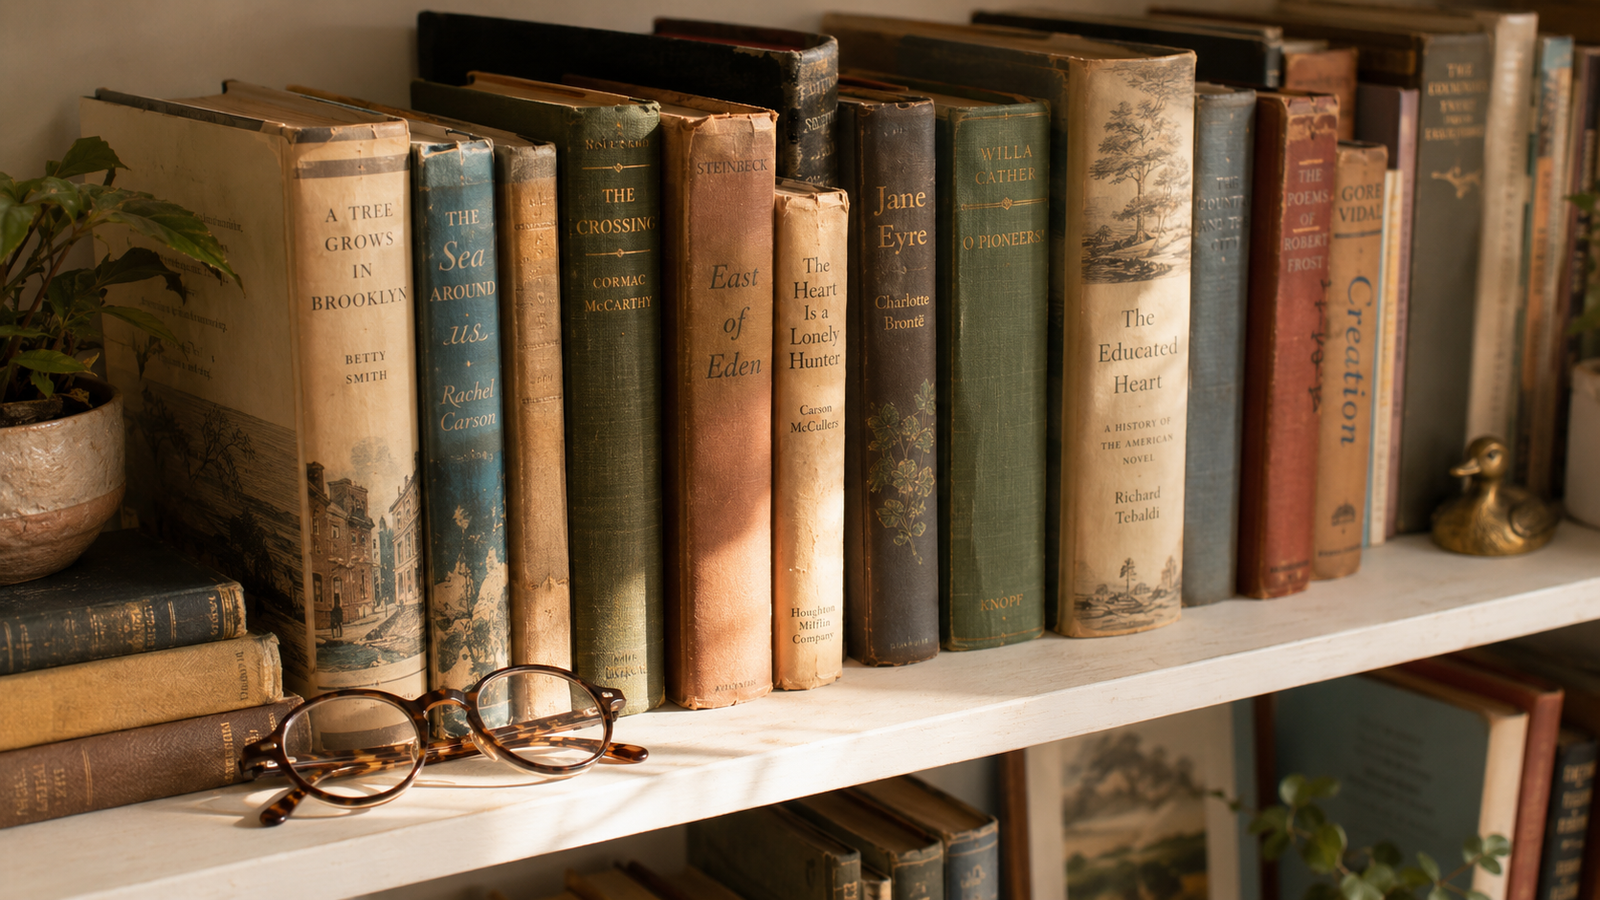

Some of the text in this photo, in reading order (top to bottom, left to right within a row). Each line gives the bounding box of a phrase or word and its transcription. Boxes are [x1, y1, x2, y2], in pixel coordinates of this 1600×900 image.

[980, 144, 1033, 161] WILLA
[697, 158, 768, 175] STEINBECK
[1298, 168, 1323, 183] THE
[975, 167, 1036, 185] CATHER
[602, 187, 635, 203] THE
[873, 186, 926, 216] Jane
[1287, 189, 1329, 207] POEMS
[1341, 183, 1382, 202] GORE
[325, 203, 394, 223] A TREE
[445, 209, 480, 227] THE
[1300, 211, 1315, 226] OF
[1339, 204, 1383, 223] VIDAL
[576, 216, 655, 235] CROSSING
[325, 231, 394, 252] GROWS
[878, 224, 928, 255] Eyre
[963, 229, 1045, 251] O PIONEERS!
[1284, 233, 1328, 251] ROBERT
[439, 240, 485, 272] Sea
[803, 256, 831, 274] The
[1287, 255, 1324, 273] FROST
[353, 263, 372, 279] IN
[708, 264, 759, 290] East
[593, 274, 646, 289] CORMAC
[793, 281, 838, 300] Heart
[312, 286, 407, 311] BROOKLYN
[430, 280, 496, 302] AROUND
[585, 296, 652, 312] McCARTHY
[875, 293, 930, 310] Charlotte
[804, 305, 829, 321] Is a
[1121, 308, 1155, 328] The
[723, 306, 750, 341] of
[884, 314, 925, 331] Brontë
[790, 325, 840, 347] Lonely
[345, 351, 386, 365] BETTY
[1098, 336, 1178, 363] Educated
[705, 351, 762, 380] Eden
[789, 351, 841, 370] Hunter
[1340, 276, 1374, 447] Creation
[346, 370, 387, 385] SMITH
[1113, 374, 1163, 395] Heart
[440, 378, 495, 409] Rachel
[799, 404, 833, 416] Carson
[440, 411, 496, 432] Carson
[790, 418, 839, 433] McCullers
[1104, 417, 1172, 433] A HISTORY OF
[1101, 433, 1174, 450] THE AMERICAN
[1123, 453, 1155, 465] NOVEL
[1115, 486, 1161, 504] Richard
[1115, 506, 1160, 525] Tebaldi
[980, 593, 1024, 612] KNOPF
[791, 605, 835, 619] Houghton
[792, 632, 834, 644] Company
